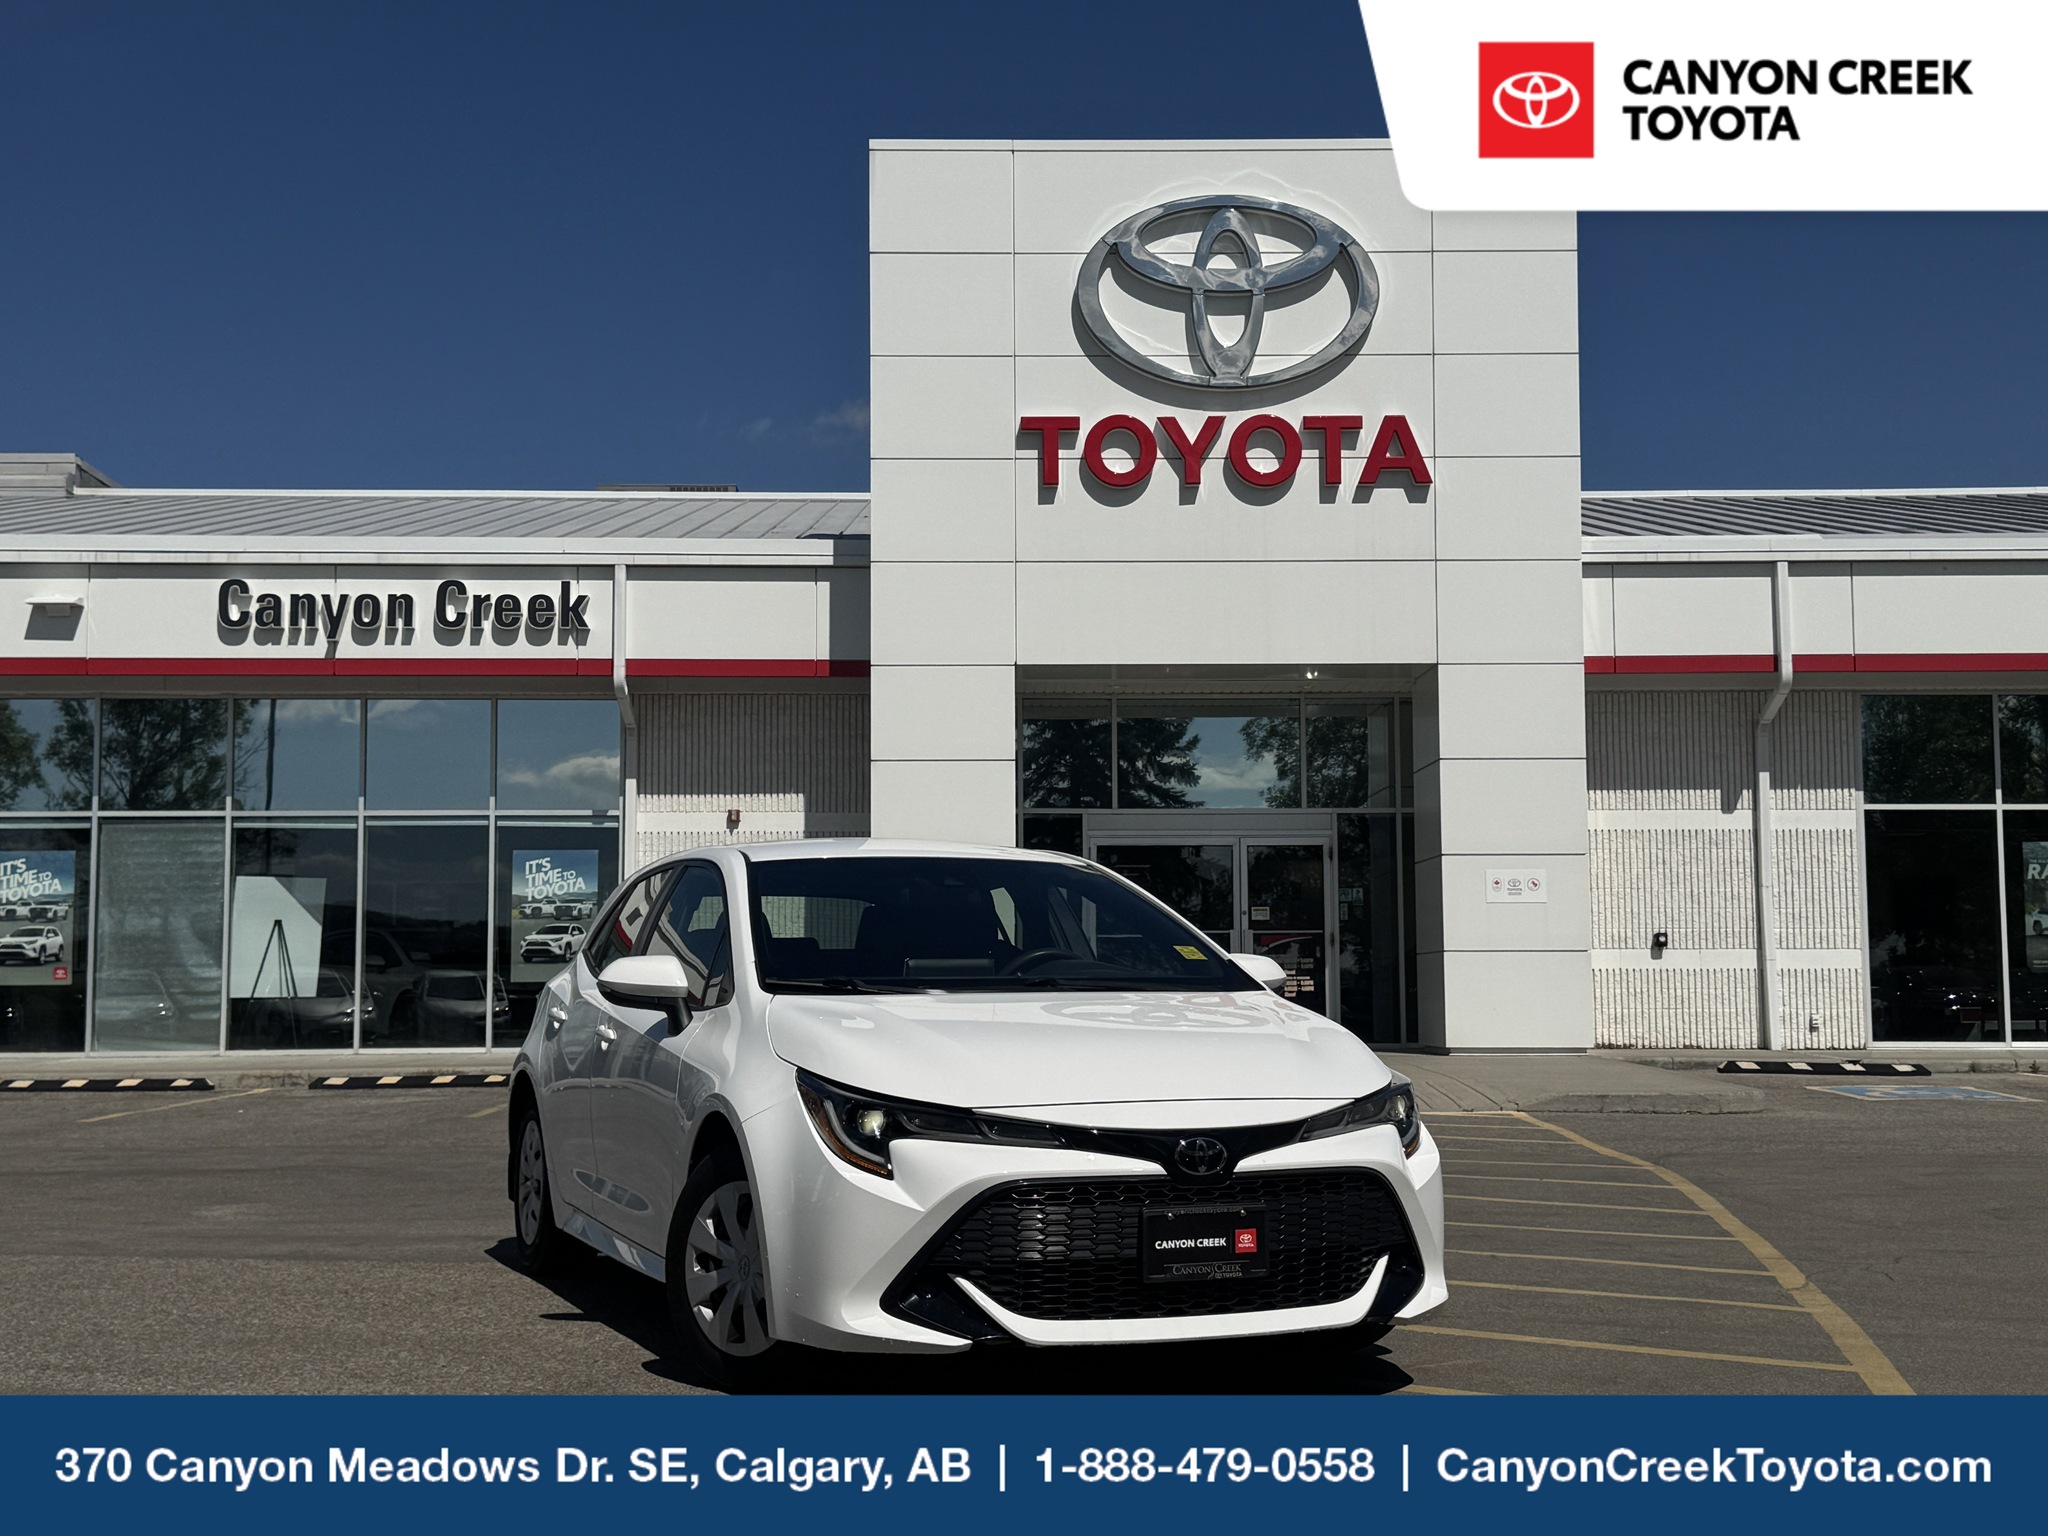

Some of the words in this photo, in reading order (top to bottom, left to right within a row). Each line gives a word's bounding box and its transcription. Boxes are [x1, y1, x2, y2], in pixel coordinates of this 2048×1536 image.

[1020, 414, 1433, 487] TOYOTA
[218, 579, 414, 641] Canyon
[435, 579, 591, 630] Creek
[0, 858, 26, 876] IT'S
[525, 857, 551, 875] IT'S
[0, 868, 38, 890] TIME
[38, 871, 52, 881] TO
[525, 868, 562, 888] TIME
[562, 870, 576, 880] TO
[0, 878, 62, 904] TOYOTA
[525, 877, 586, 902] TOYOTA
[1155, 1239, 1195, 1250] CANYON
[1196, 1237, 1227, 1248] CREEK
